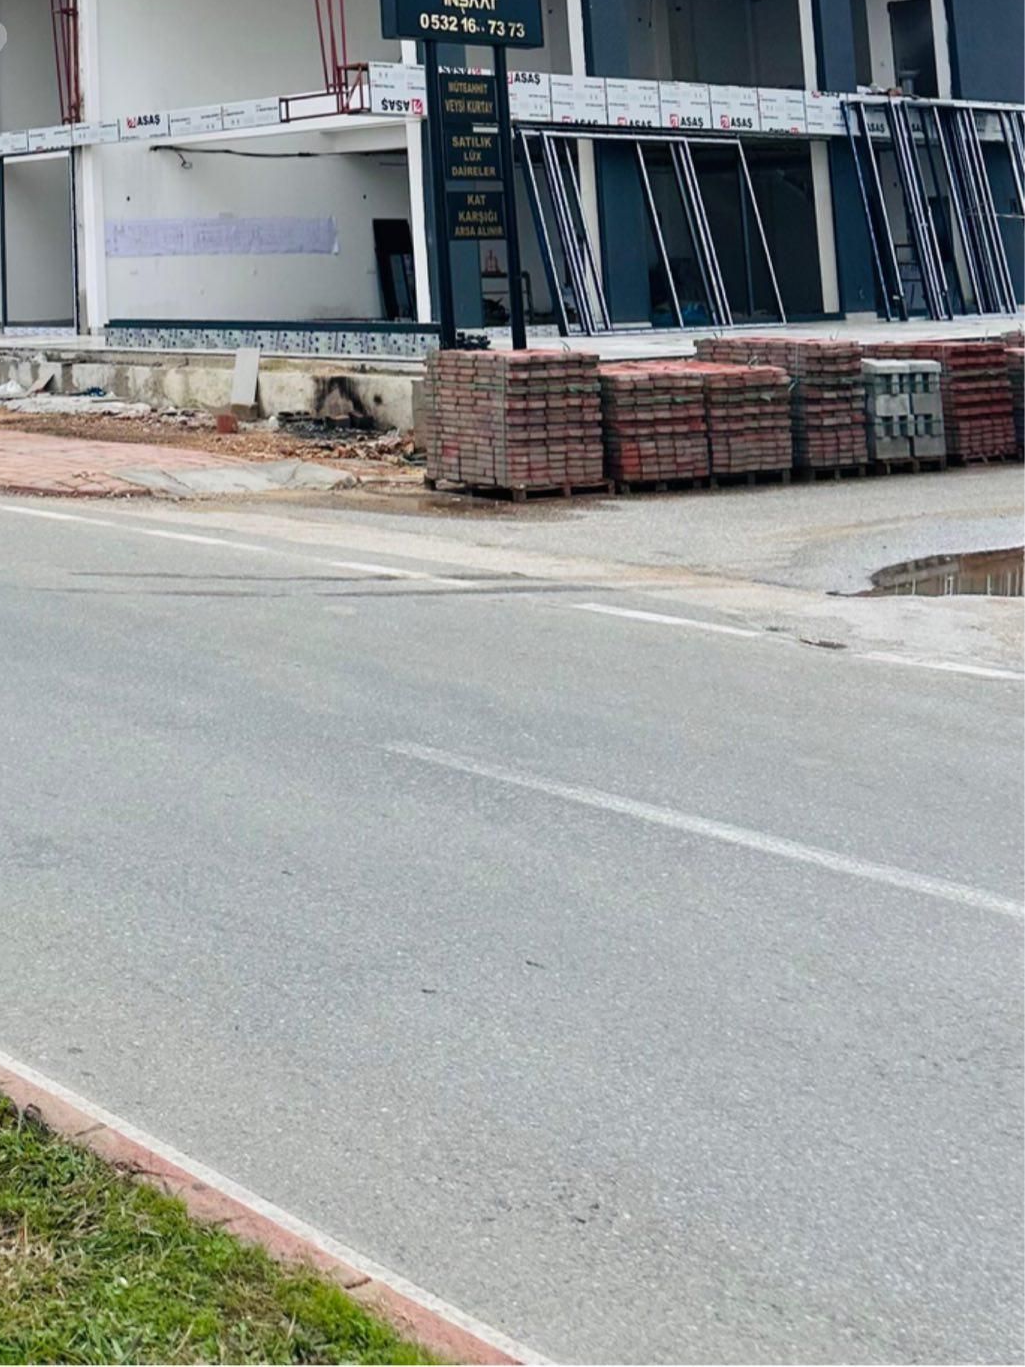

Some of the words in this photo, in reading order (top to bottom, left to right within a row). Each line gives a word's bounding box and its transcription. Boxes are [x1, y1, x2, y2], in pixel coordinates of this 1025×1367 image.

[514, 71, 540, 84] ASAŞ
[137, 114, 161, 127] ASAŞ
[452, 136, 492, 148] SATILIK
[464, 149, 482, 161] LÜX
[451, 165, 496, 177] DAİRELER
[467, 194, 486, 206] KAT
